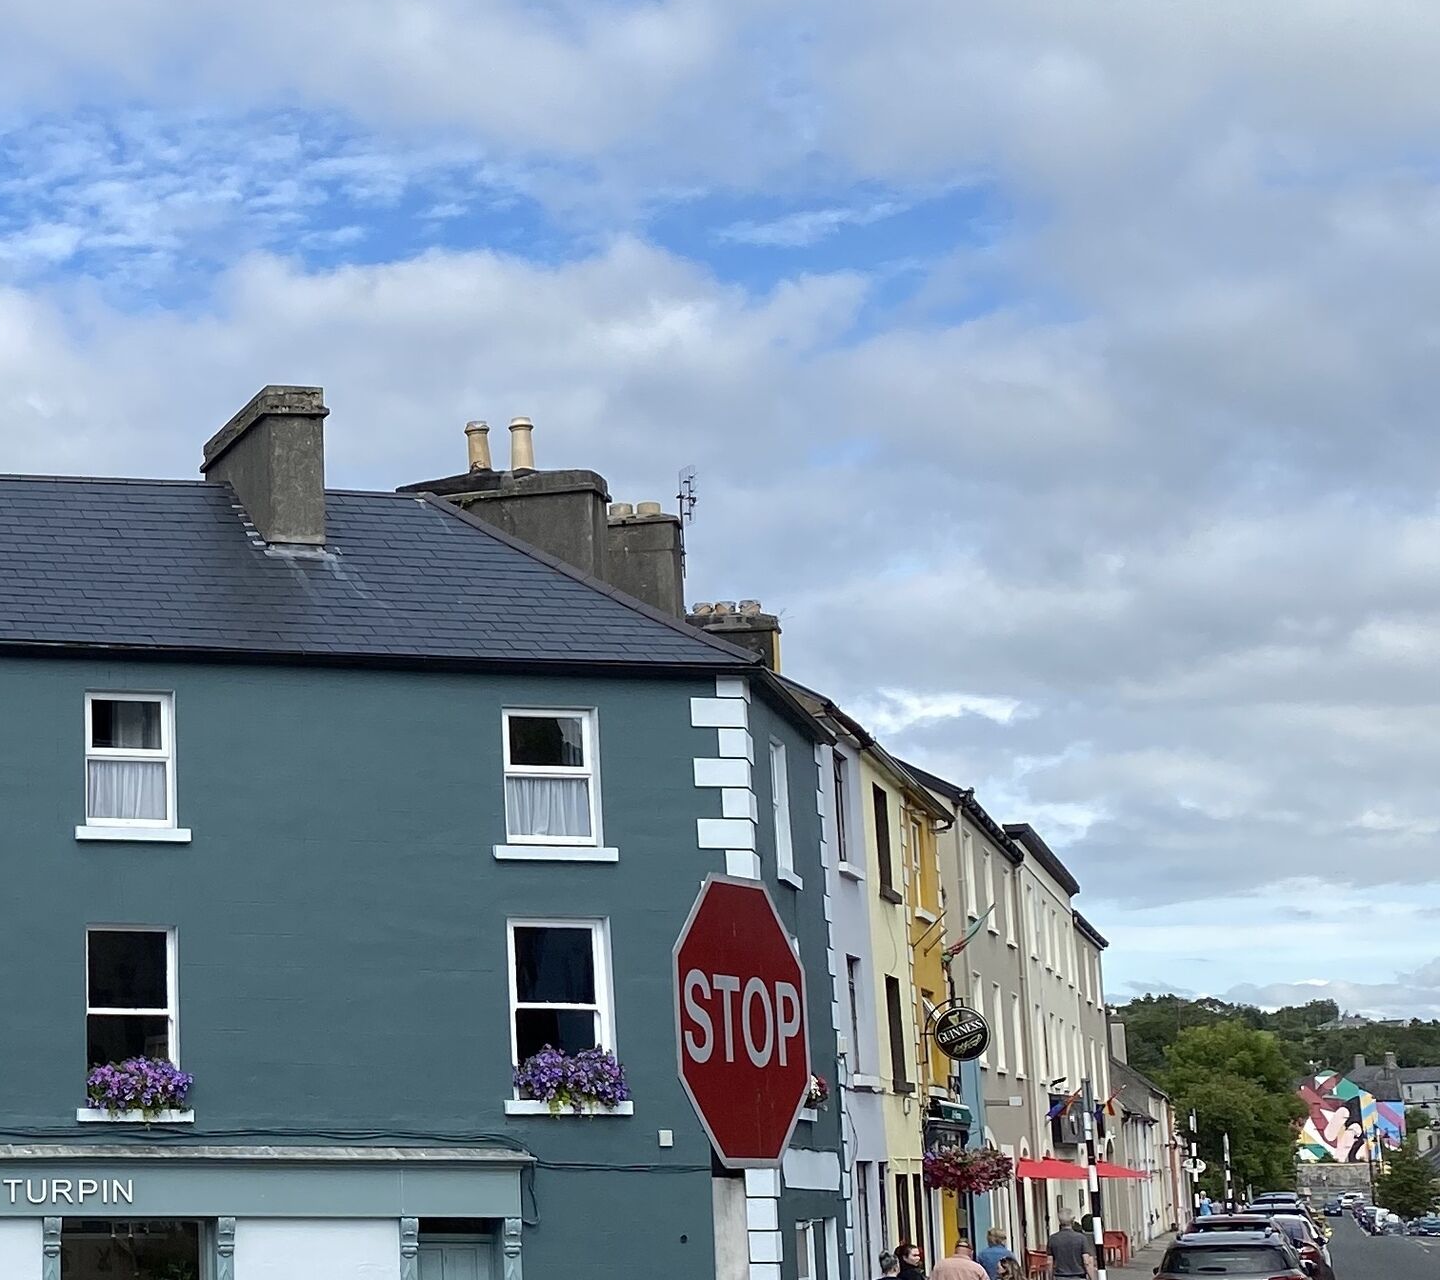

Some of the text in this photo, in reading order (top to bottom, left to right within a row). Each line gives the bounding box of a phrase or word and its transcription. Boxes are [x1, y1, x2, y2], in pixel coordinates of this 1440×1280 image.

[683, 968, 802, 1069] STOP
[937, 1020, 983, 1044] GUINNESS
[3, 1179, 134, 1205] TURPIN
